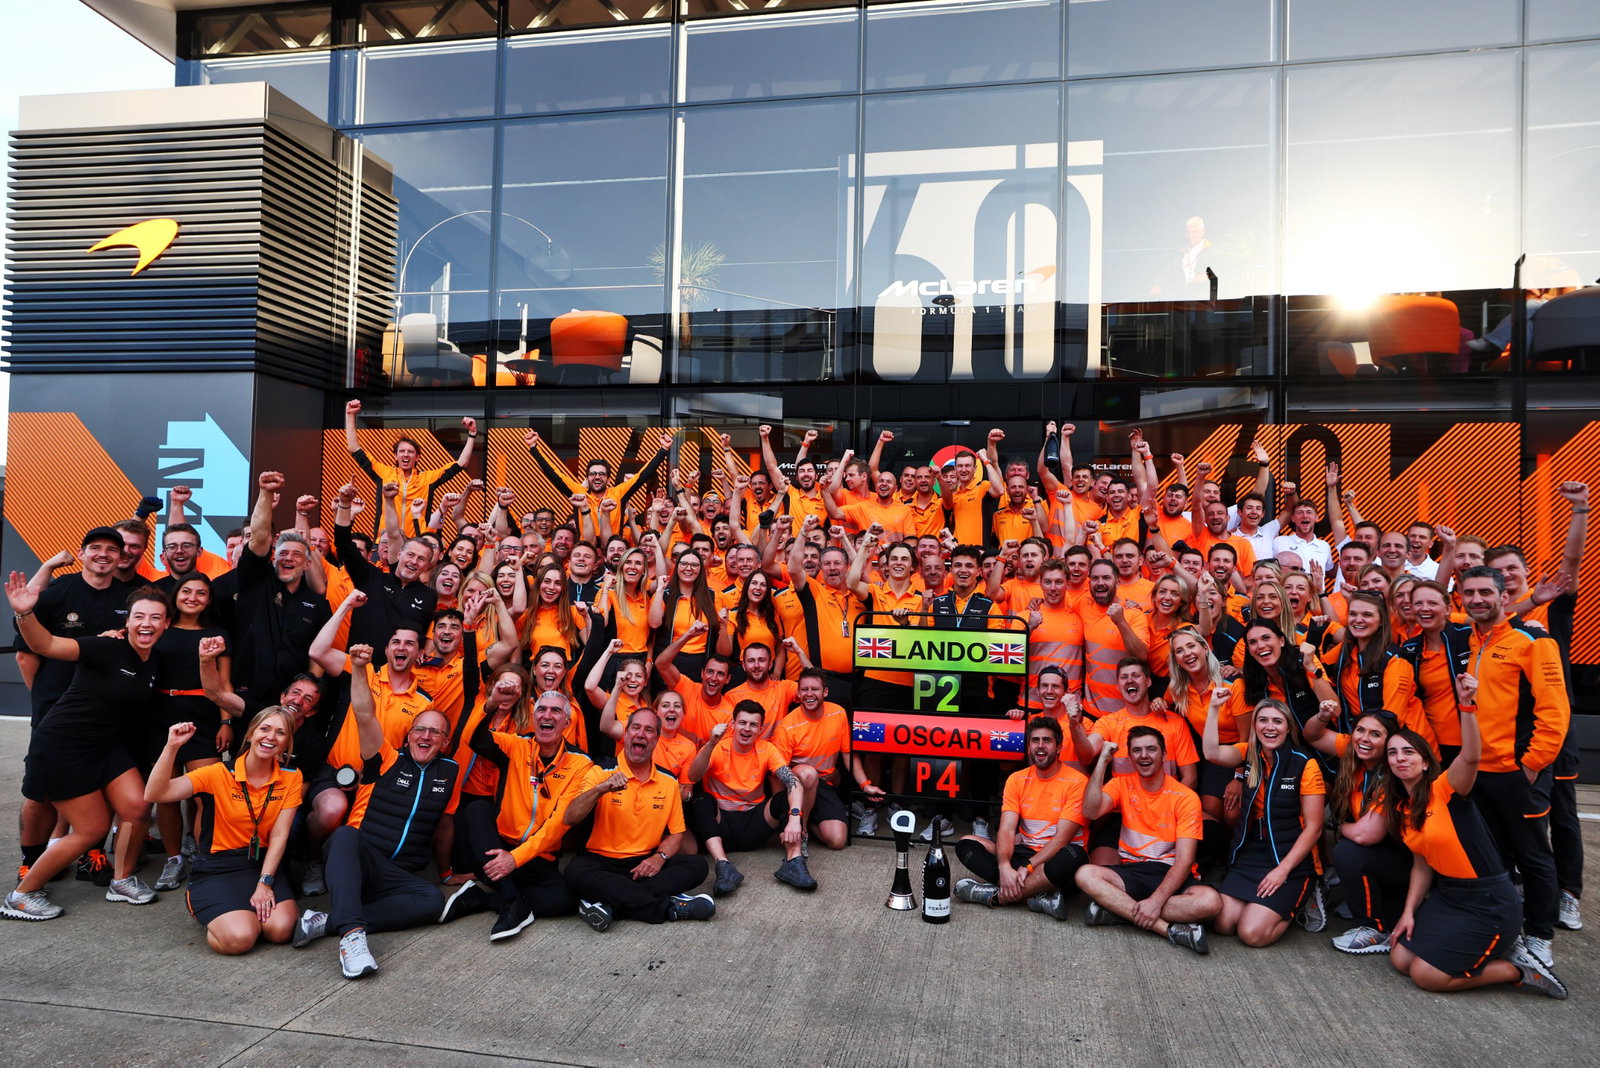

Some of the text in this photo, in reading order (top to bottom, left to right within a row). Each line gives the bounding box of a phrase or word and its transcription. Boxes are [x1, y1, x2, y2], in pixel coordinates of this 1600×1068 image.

[878, 279, 1036, 297] McLaren
[911, 304, 1038, 316] FORMULA 1 TEAM
[891, 640, 988, 663] LANDO
[913, 674, 960, 712] P2
[893, 724, 982, 750] OSCAR
[916, 760, 960, 798] P4
